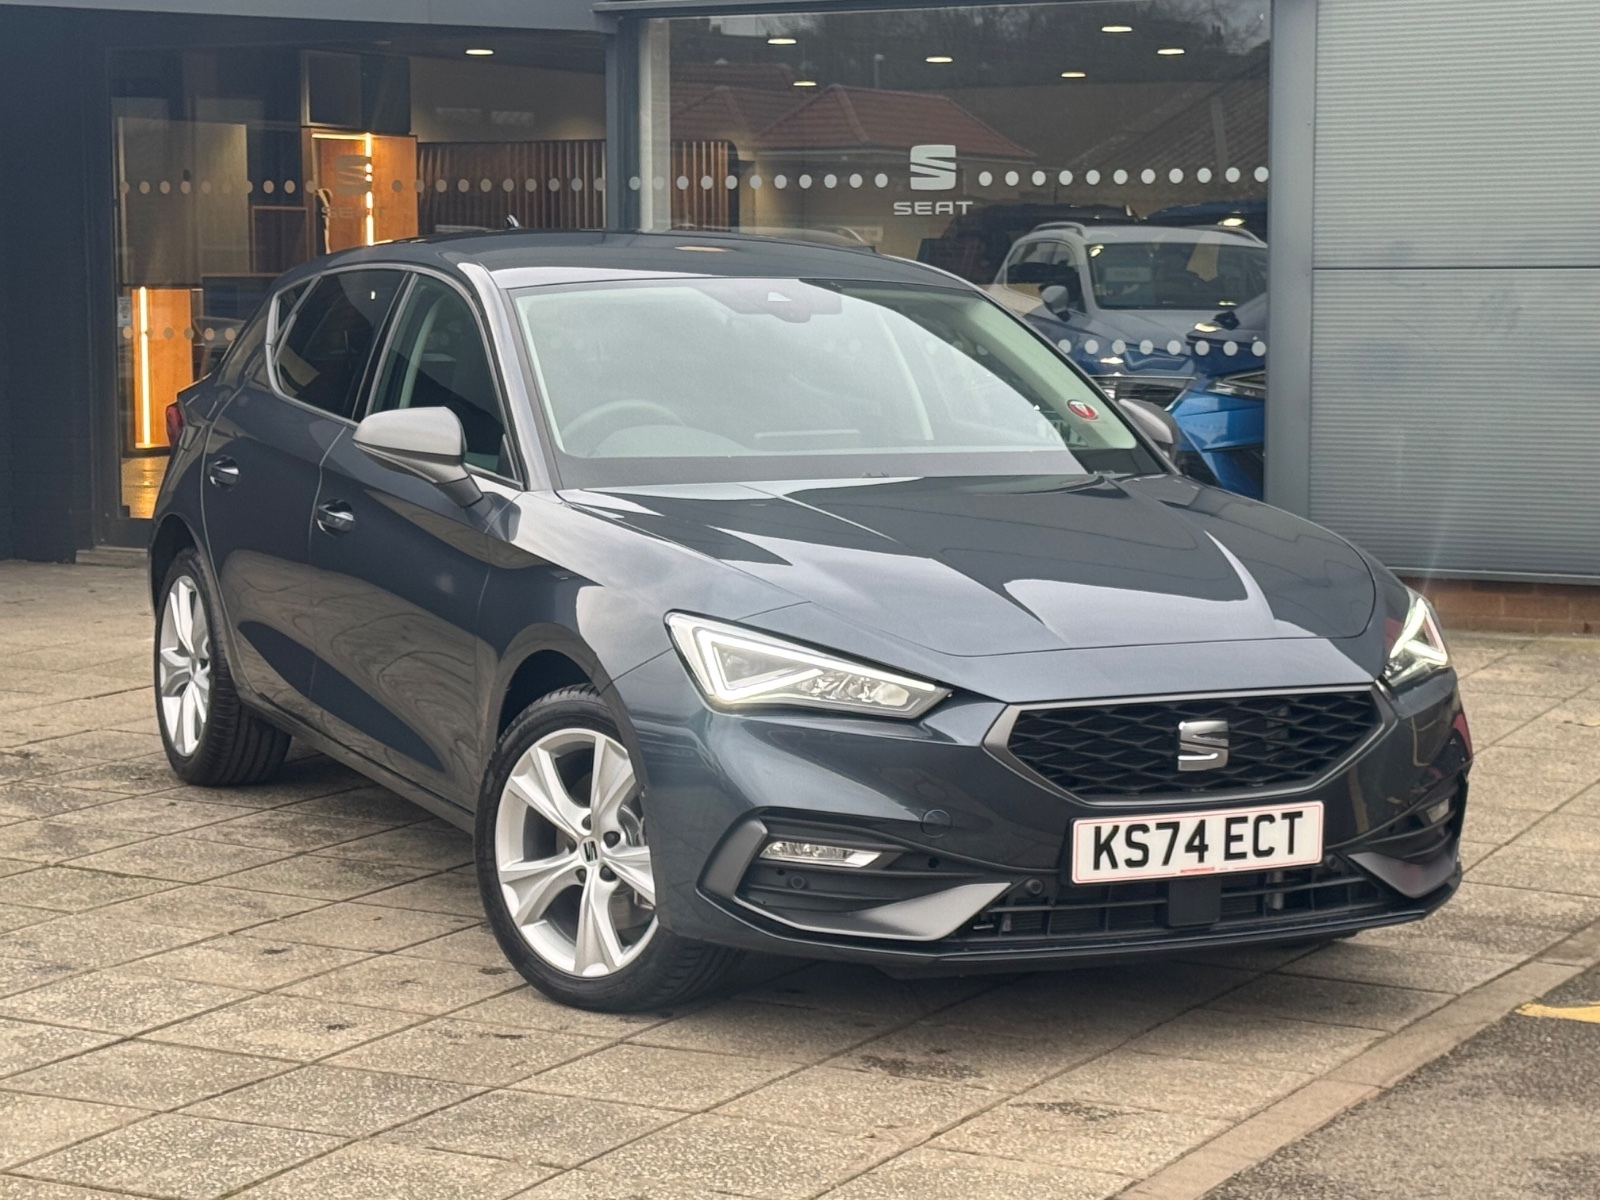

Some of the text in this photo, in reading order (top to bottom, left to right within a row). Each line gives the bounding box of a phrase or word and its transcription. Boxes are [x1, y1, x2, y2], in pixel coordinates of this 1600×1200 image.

[893, 201, 974, 216] SEAT
[1093, 811, 1303, 870] KS74 ECT
